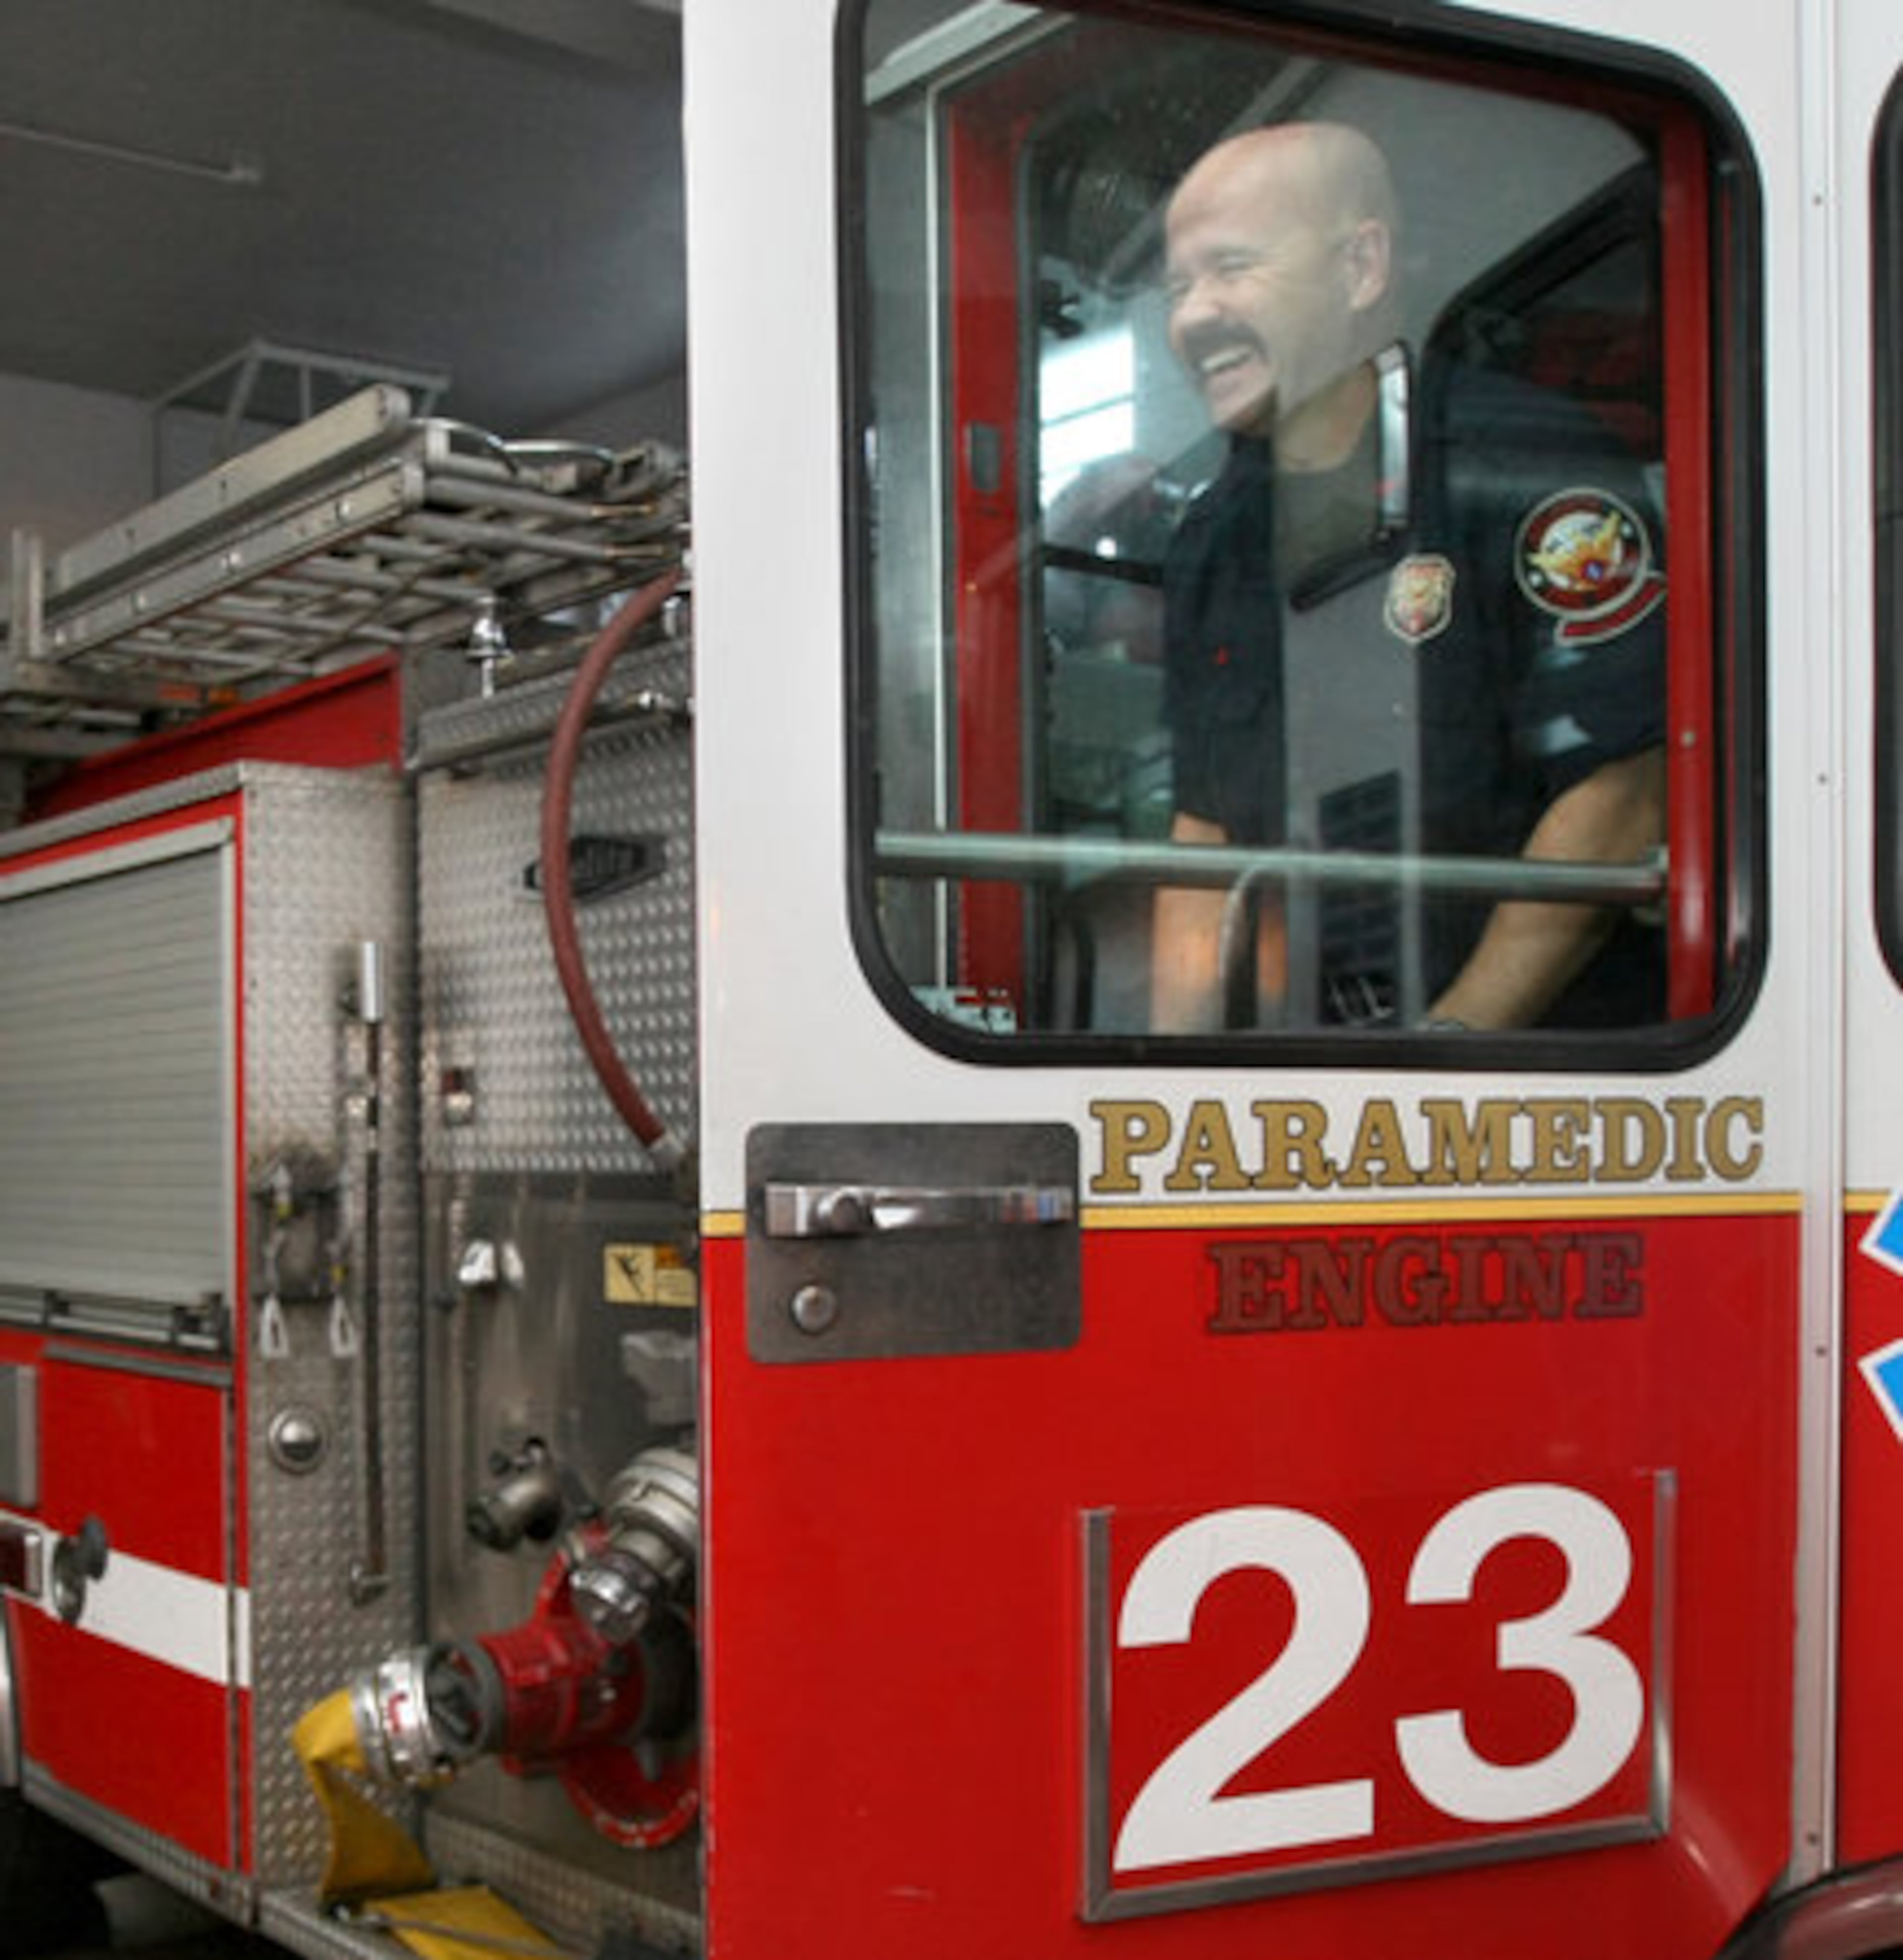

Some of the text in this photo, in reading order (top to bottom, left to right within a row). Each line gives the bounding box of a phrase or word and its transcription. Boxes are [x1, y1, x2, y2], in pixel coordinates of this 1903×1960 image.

[1090, 1096, 1764, 1193] PARAMEDIC
[1206, 1232, 1645, 1334] ENGINE
[1113, 1483, 1644, 1872] 23
